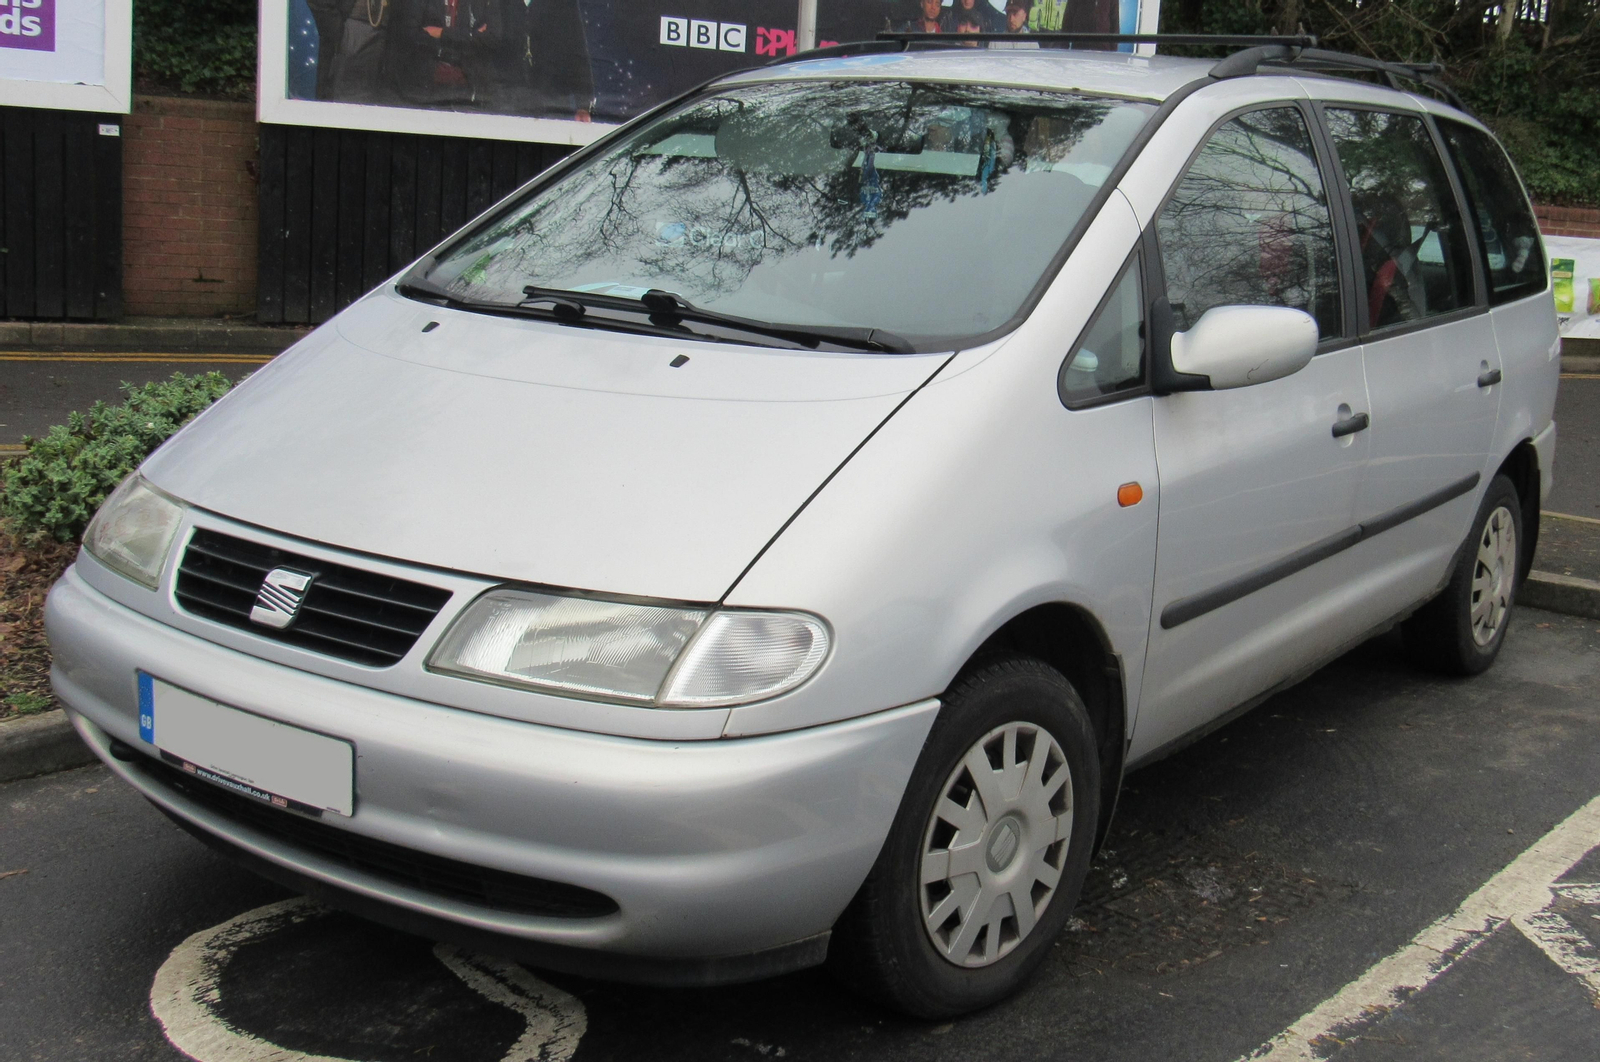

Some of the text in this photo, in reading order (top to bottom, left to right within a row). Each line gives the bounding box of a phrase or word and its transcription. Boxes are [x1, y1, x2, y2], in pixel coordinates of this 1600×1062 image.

[665, 19, 743, 50] BBC
[141, 713, 152, 730] GB
[197, 768, 271, 801] www.drivevauxhall.co.uk
